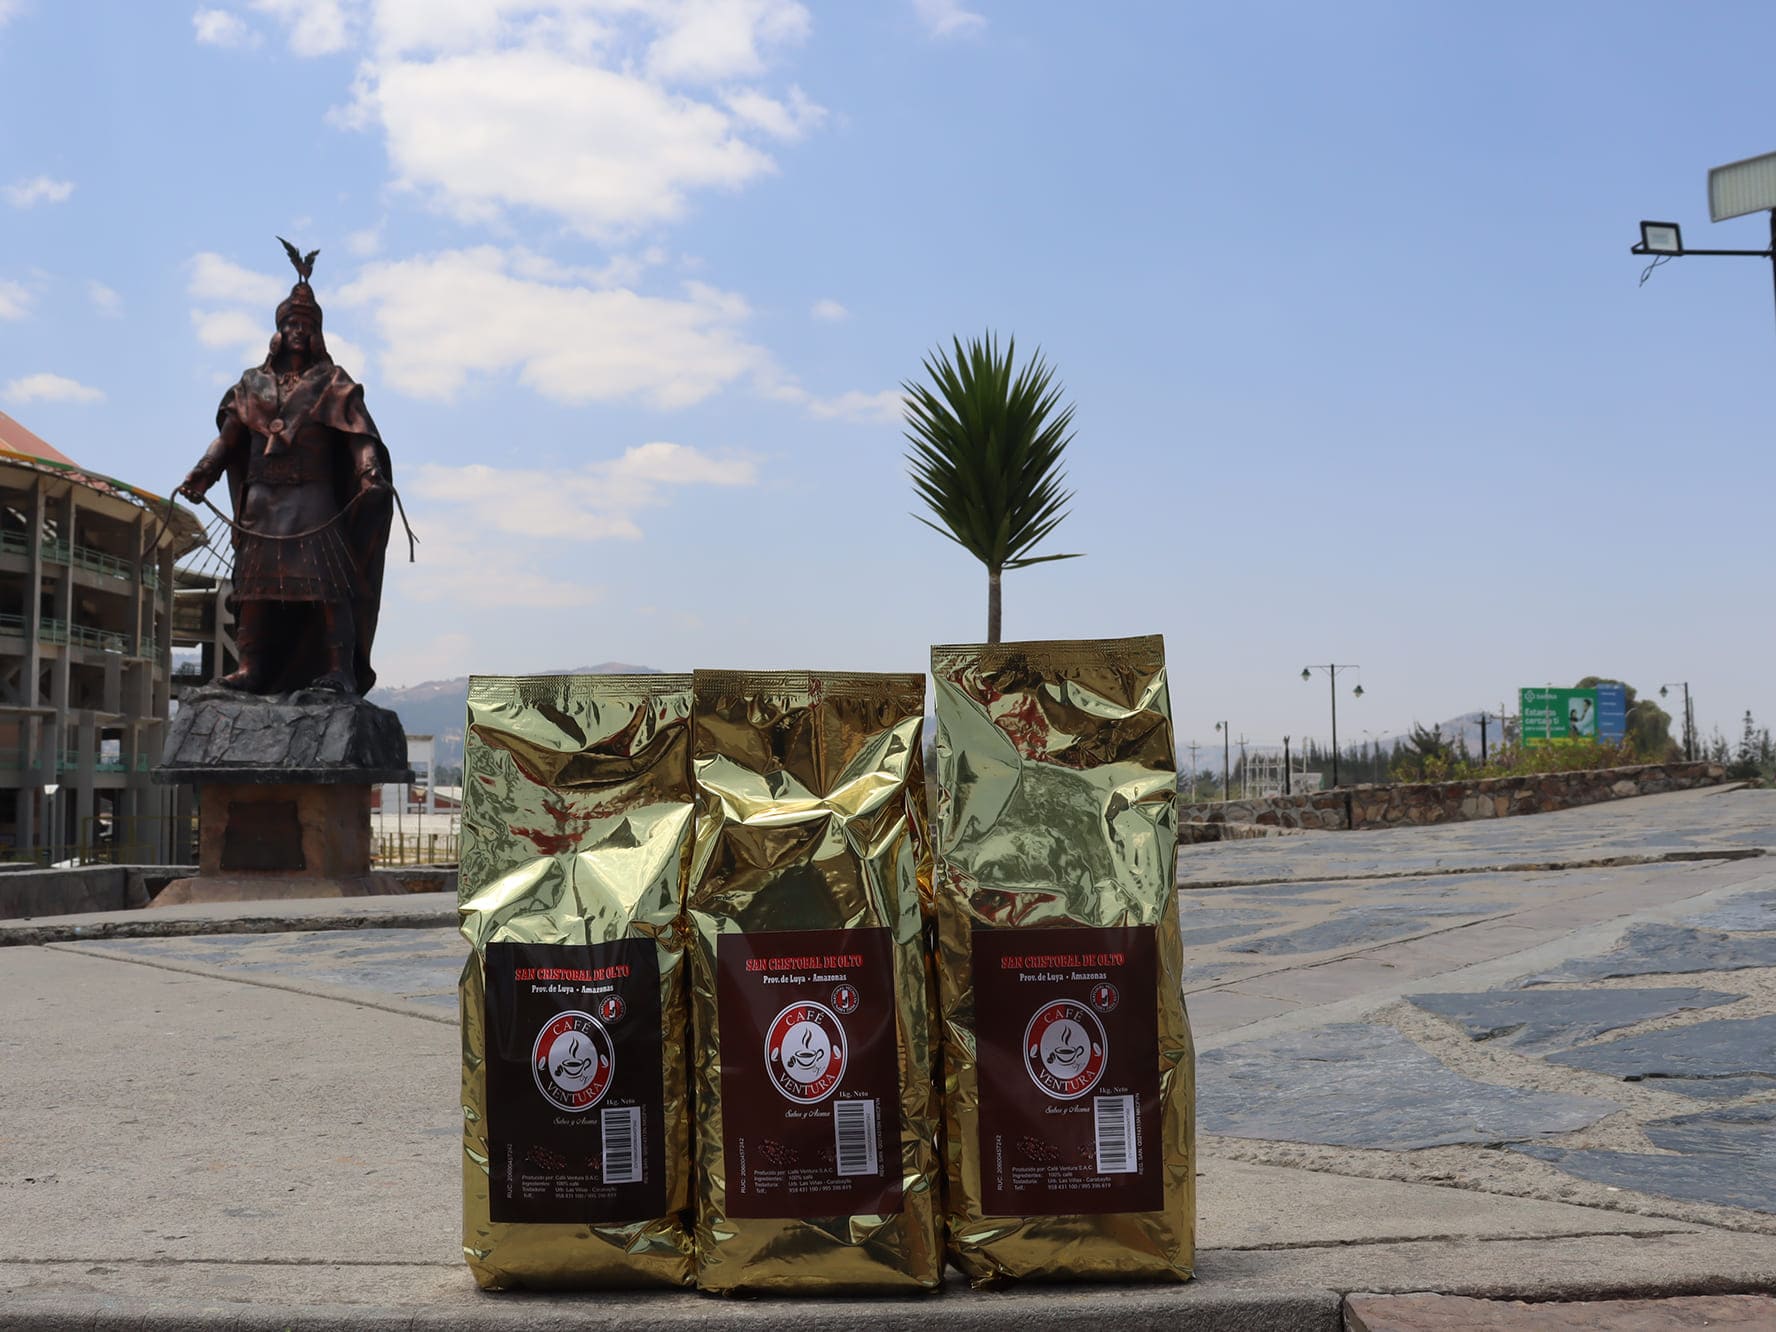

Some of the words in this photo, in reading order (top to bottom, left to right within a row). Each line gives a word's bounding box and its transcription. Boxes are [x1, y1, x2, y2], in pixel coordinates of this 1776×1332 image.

[746, 959, 767, 971] SAN
[768, 957, 822, 970] CRISTOBAL
[824, 956, 836, 968] DE
[838, 954, 863, 967] OLTO
[1001, 956, 1023, 969] SAN
[1025, 954, 1081, 968] CRISTOBAL
[1082, 954, 1096, 966] DE
[1097, 953, 1124, 966] OLTO
[515, 968, 534, 980] SAN
[537, 967, 592, 981] CRISTOBAL
[594, 967, 604, 980] DE
[606, 964, 630, 979] OLTO
[781, 975, 788, 983] de
[790, 975, 806, 984] Luya
[813, 974, 846, 982] Amazonas
[1038, 973, 1046, 981] de
[1047, 973, 1063, 982] Luya
[1071, 972, 1106, 980] Amazonas
[548, 984, 556, 993] de
[558, 985, 574, 994] Luya
[581, 985, 614, 994] Amazonas
[786, 1010, 824, 1026] CAFÉ
[1044, 1008, 1083, 1023] CAFÉ
[553, 1020, 591, 1035] CAFÉ
[780, 1072, 835, 1095] VENTURA
[1039, 1068, 1096, 1091] VENTURA
[546, 1081, 602, 1103] VENTURA
